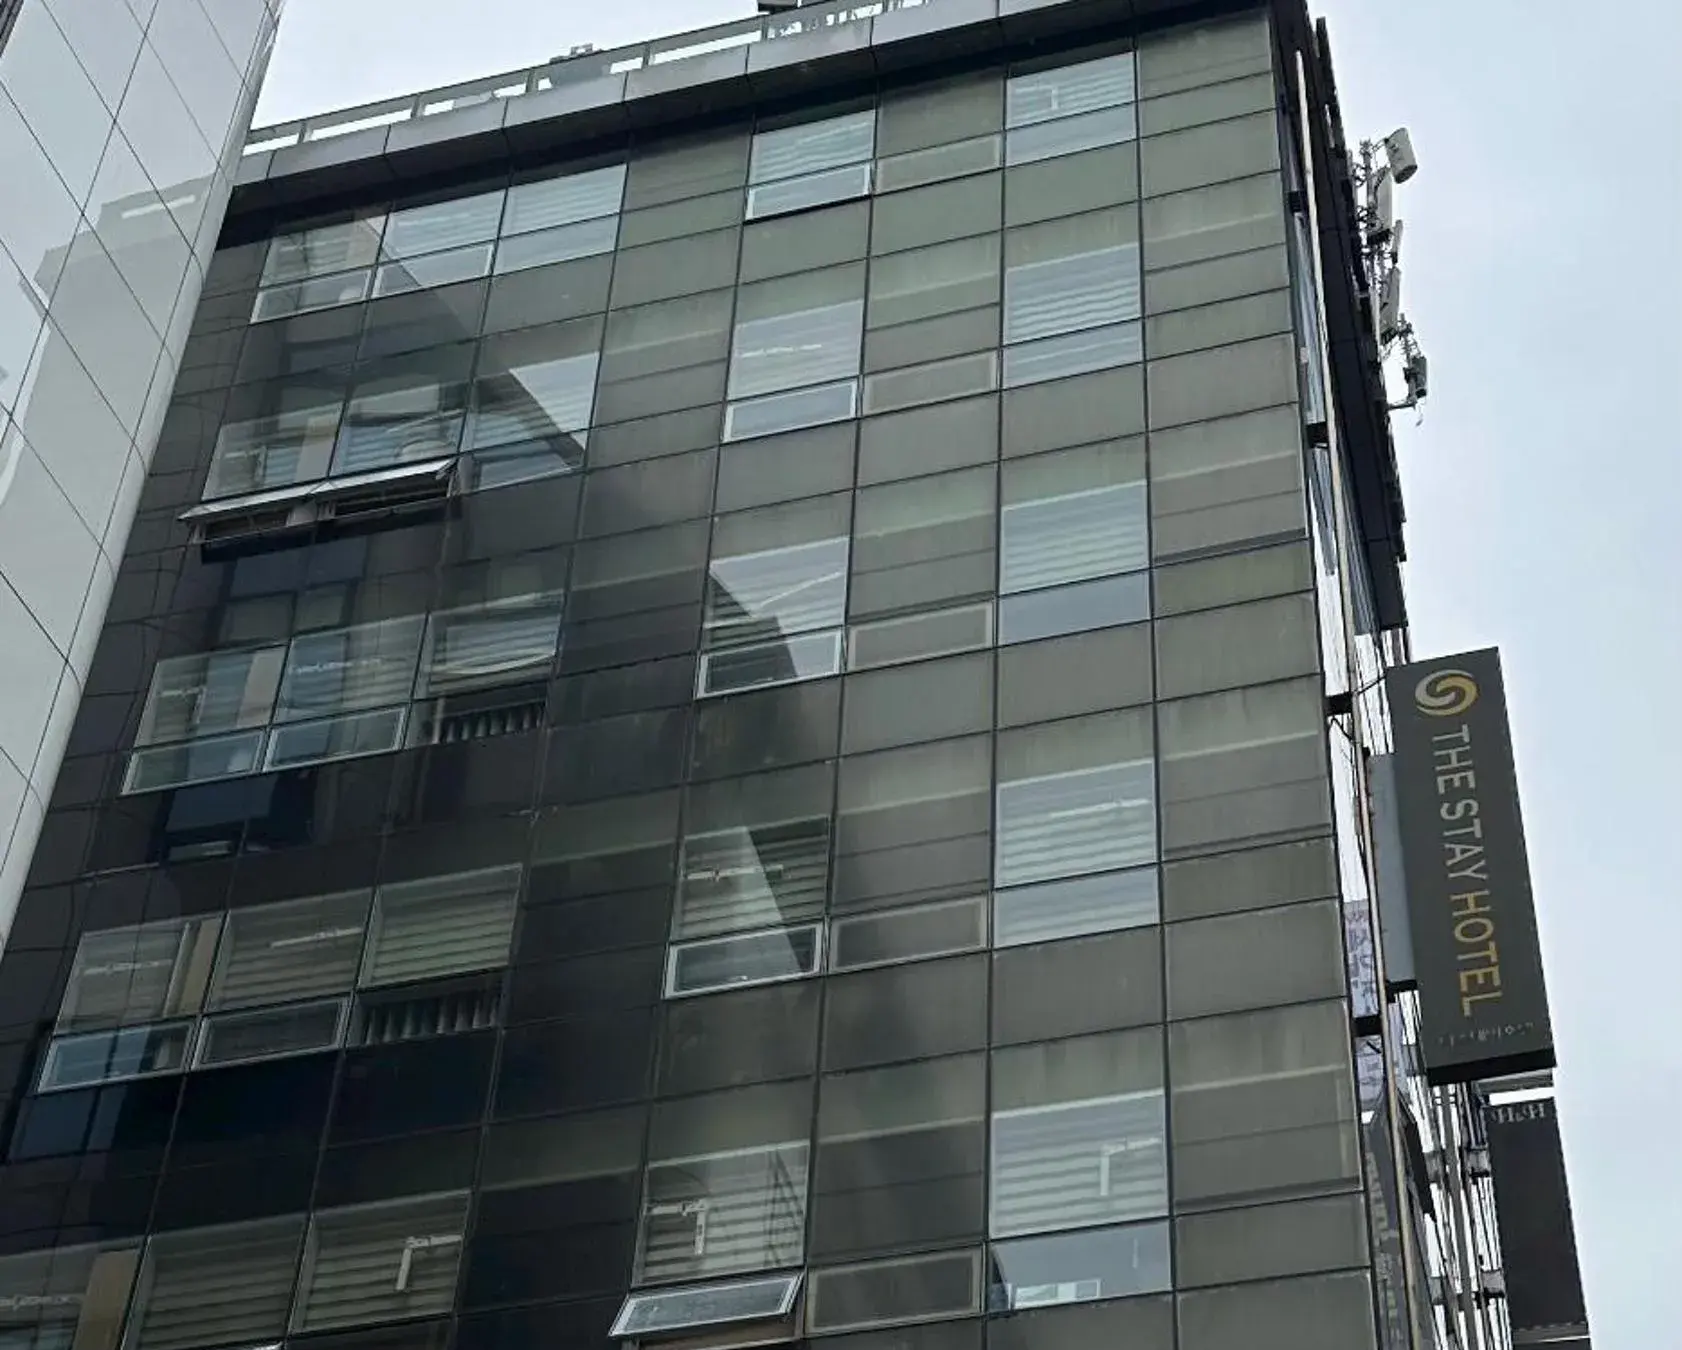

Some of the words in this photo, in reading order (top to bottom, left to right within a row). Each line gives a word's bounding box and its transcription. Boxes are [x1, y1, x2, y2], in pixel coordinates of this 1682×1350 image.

[1432, 723, 1477, 802] THE
[1439, 800, 1490, 882] STAY
[1451, 889, 1503, 1018] HOTEL
